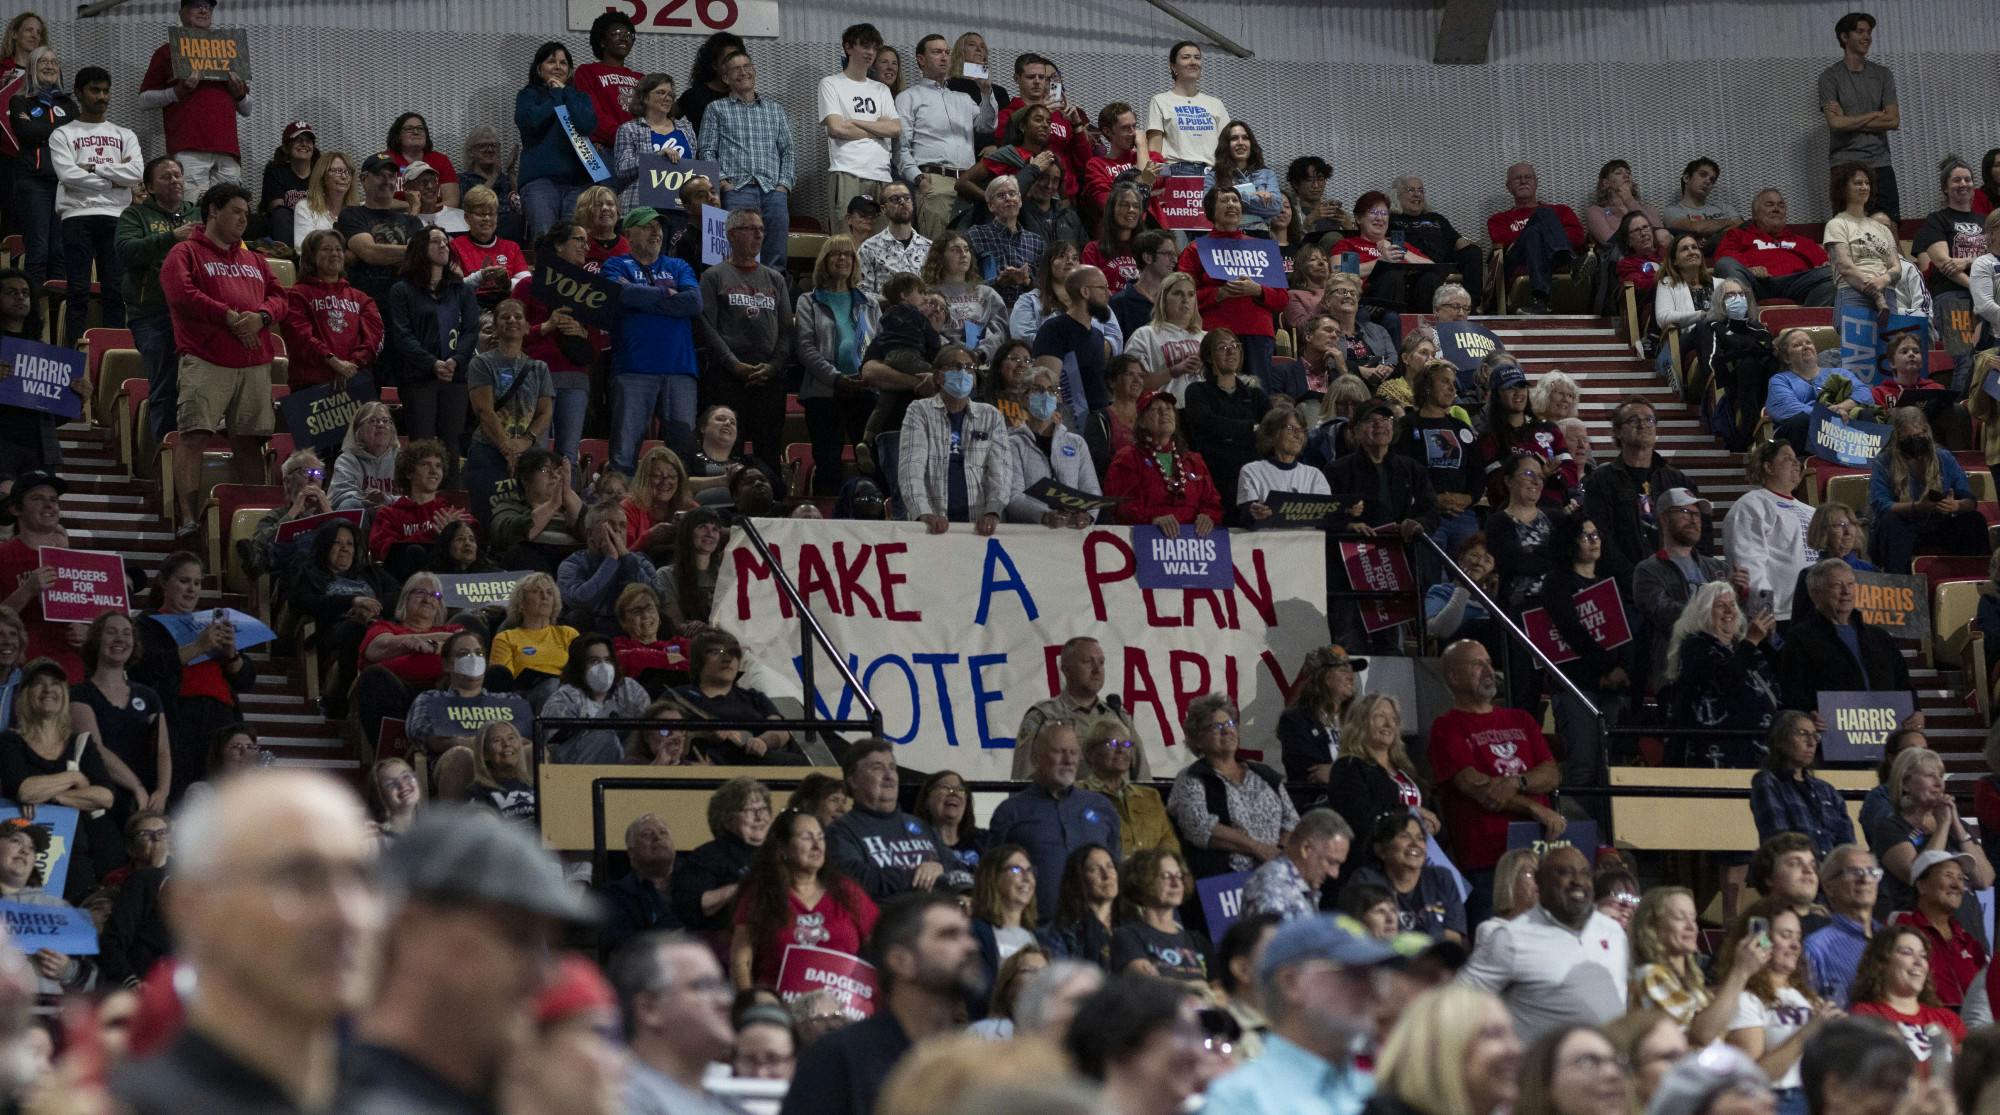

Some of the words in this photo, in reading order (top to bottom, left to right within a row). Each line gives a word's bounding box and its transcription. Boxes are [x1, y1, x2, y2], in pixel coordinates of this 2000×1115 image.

[180, 37, 238, 58] HARRIS
[190, 59, 229, 72] WALZ
[852, 96, 877, 115] 20
[649, 167, 711, 191] vot
[1212, 249, 1271, 268] HARRIS
[205, 261, 263, 282] WISCONSIN
[1224, 264, 1265, 278] WALZ
[547, 267, 608, 309] vote
[15, 353, 73, 384] HARRIS
[22, 378, 63, 400] WALZ
[1820, 418, 1882, 444] WISCONSIN
[1817, 430, 1846, 453] VOTES
[1848, 440, 1882, 459] EARLY
[1279, 501, 1341, 516] HARRIS
[1284, 511, 1327, 521] WALZ
[1151, 538, 1216, 562] HARRIS
[57, 568, 110, 584] BADGERS
[1161, 563, 1208, 576] WALZ
[72, 580, 95, 595] FOR
[455, 581, 517, 597] HARRIS
[732, 538, 924, 622] MAKE
[975, 537, 1037, 622] A
[47, 591, 125, 608] HARRIS-WALZ
[466, 593, 511, 603] WALZ
[1863, 609, 1906, 626] WALZ
[793, 651, 1017, 749] VOTE
[448, 706, 514, 722] HARRIS
[1836, 708, 1898, 732] HARRIS
[1848, 730, 1890, 745] WALZ
[4, 909, 69, 928] ARRIS
[803, 969, 874, 999] BADGERS
